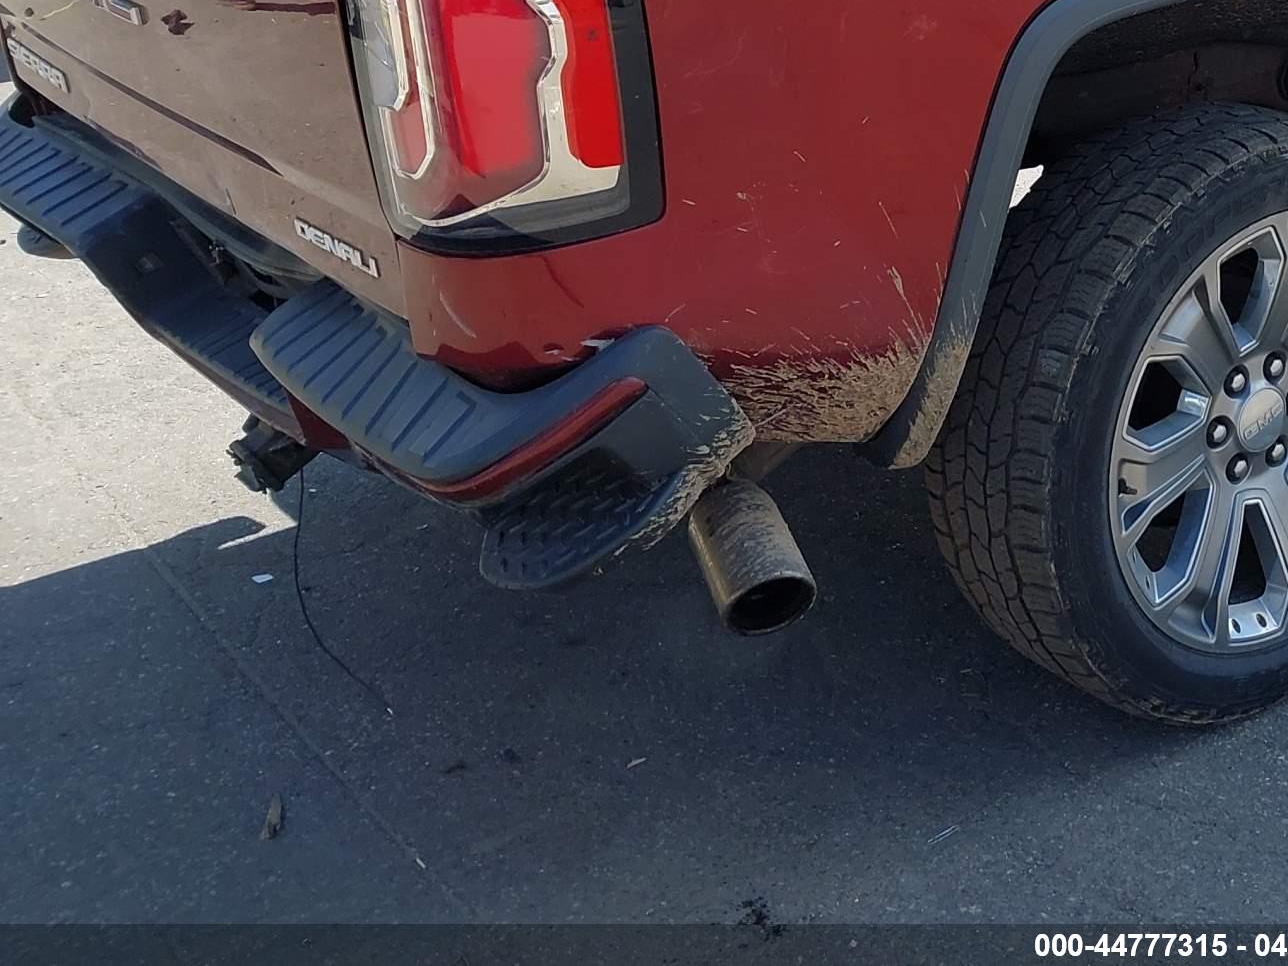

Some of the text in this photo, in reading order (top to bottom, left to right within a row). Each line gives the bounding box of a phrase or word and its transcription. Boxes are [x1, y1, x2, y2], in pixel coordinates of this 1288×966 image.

[7, 37, 70, 94] SIERRA
[293, 217, 380, 279] DENALI
[1243, 402, 1283, 442] GMC
